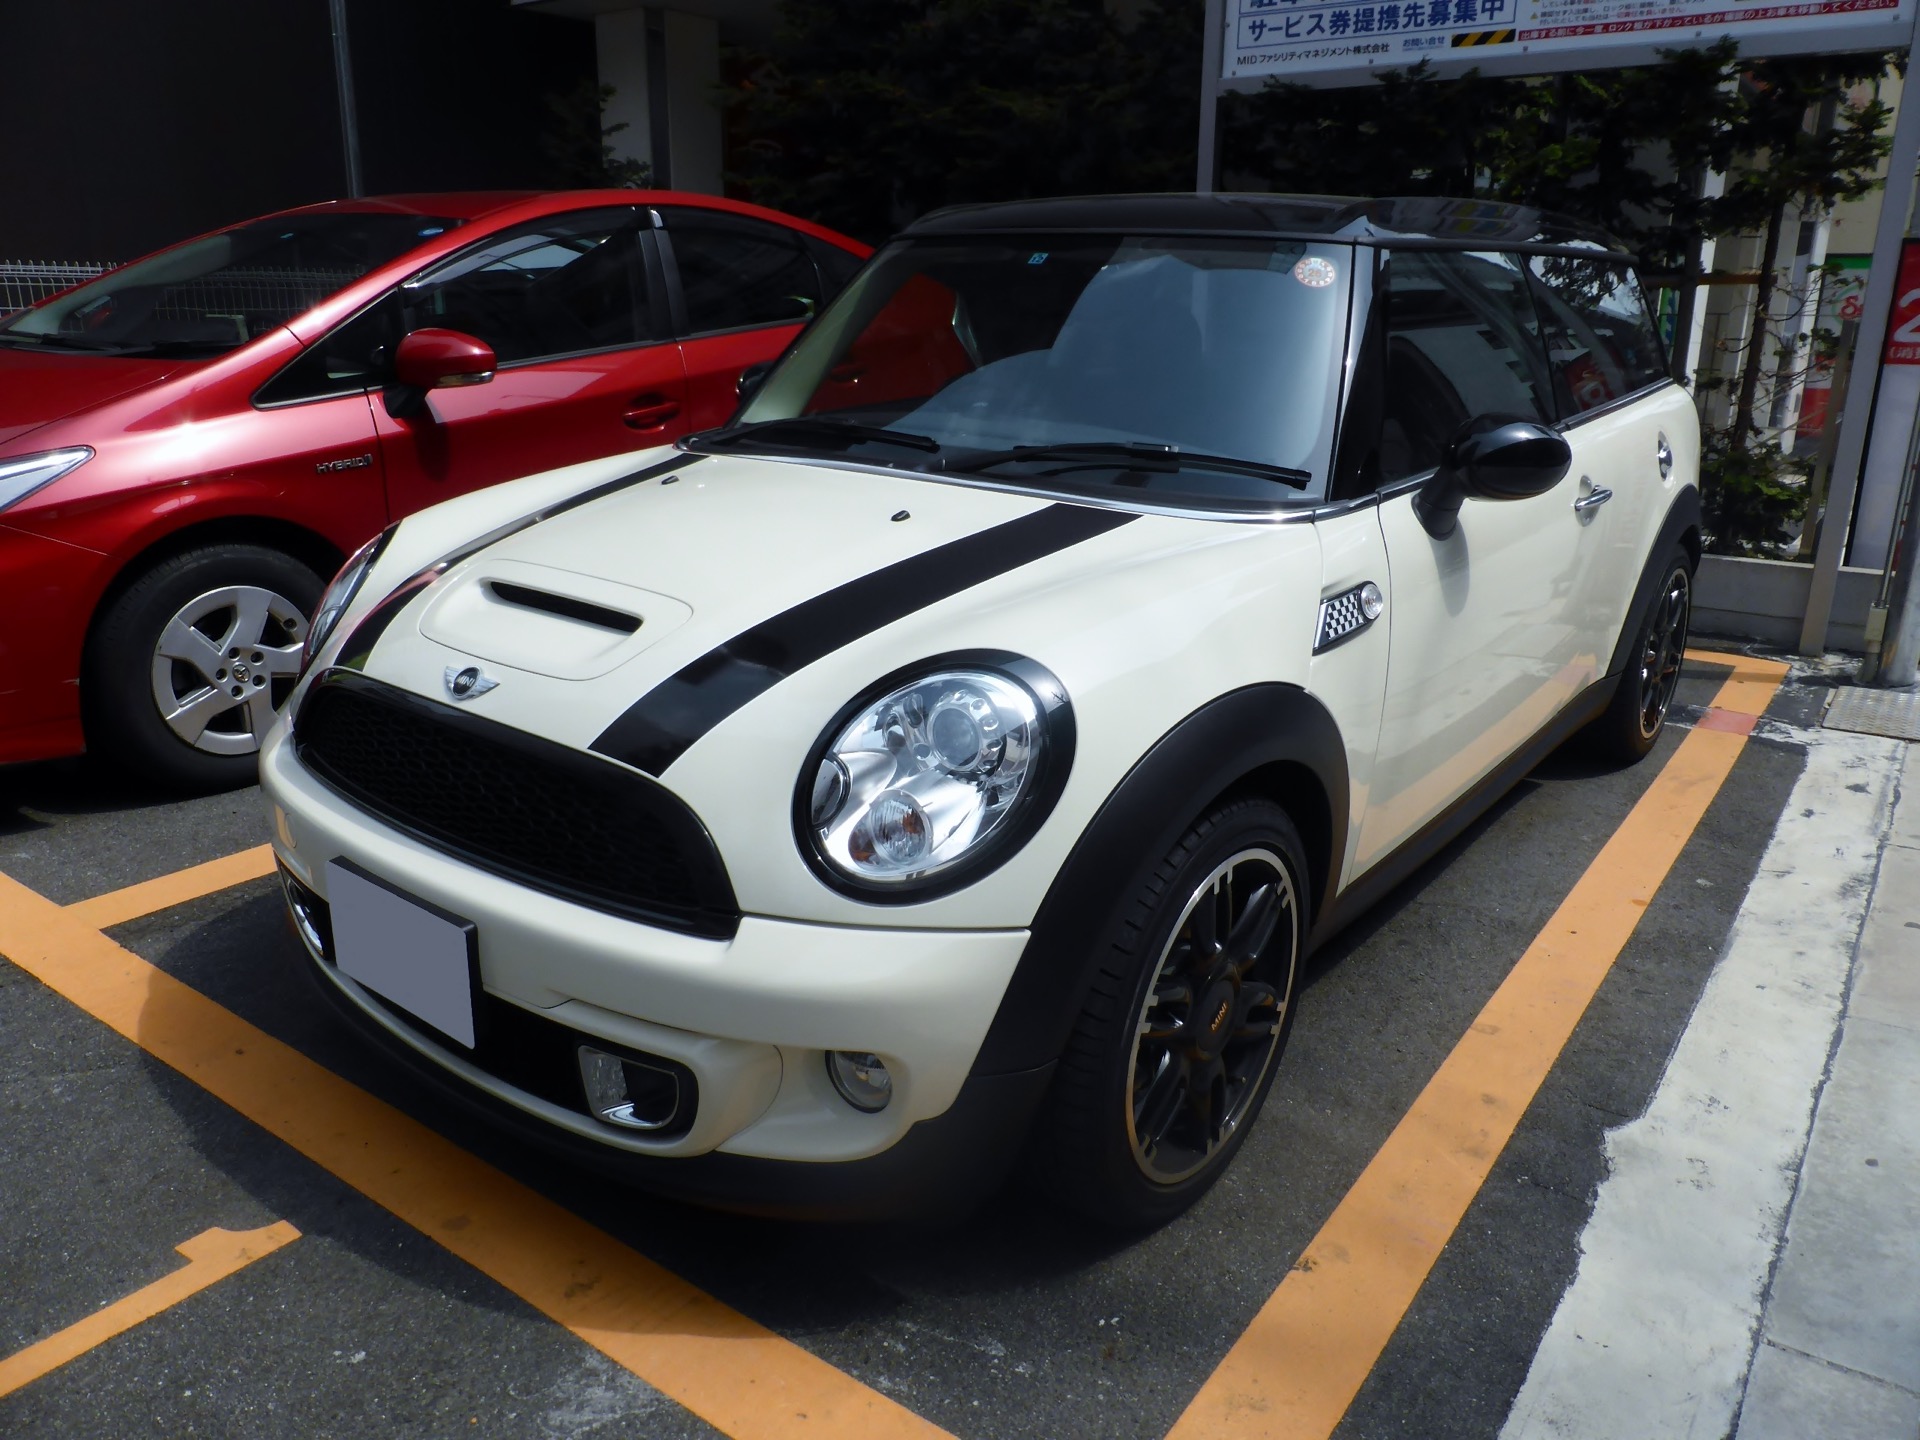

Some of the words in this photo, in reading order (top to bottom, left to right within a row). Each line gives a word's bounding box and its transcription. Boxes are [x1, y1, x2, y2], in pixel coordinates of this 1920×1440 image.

[1249, 0, 1504, 42] サービス券提携先募集中
[1237, 55, 1257, 66] MID
[1259, 43, 1390, 63] ファシリティマネジメント株式会社
[316, 457, 365, 473] HYBRID
[456, 675, 476, 687] MINI
[1211, 1002, 1226, 1031] MINI
